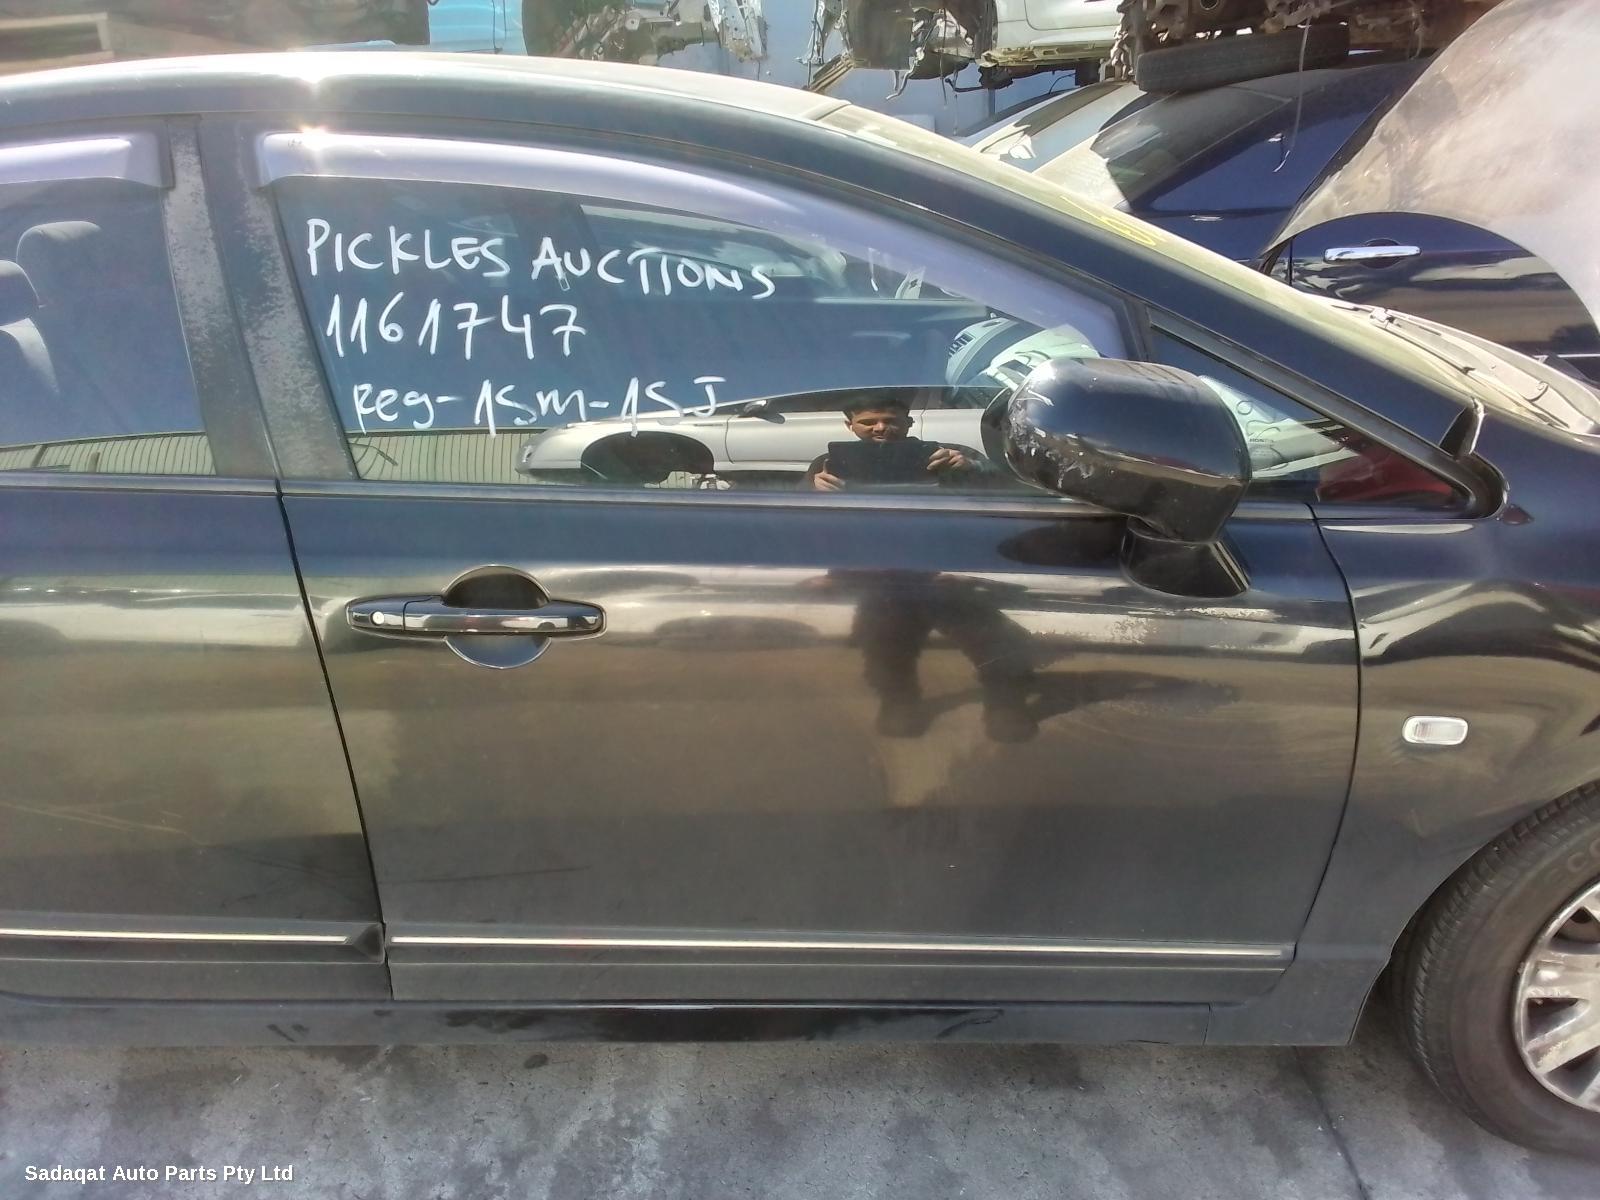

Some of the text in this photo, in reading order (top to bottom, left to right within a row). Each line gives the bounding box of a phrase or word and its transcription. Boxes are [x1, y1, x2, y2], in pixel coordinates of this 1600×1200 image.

[306, 218, 776, 300] PICKLES AUCTIONS
[326, 292, 586, 360] 1161747
